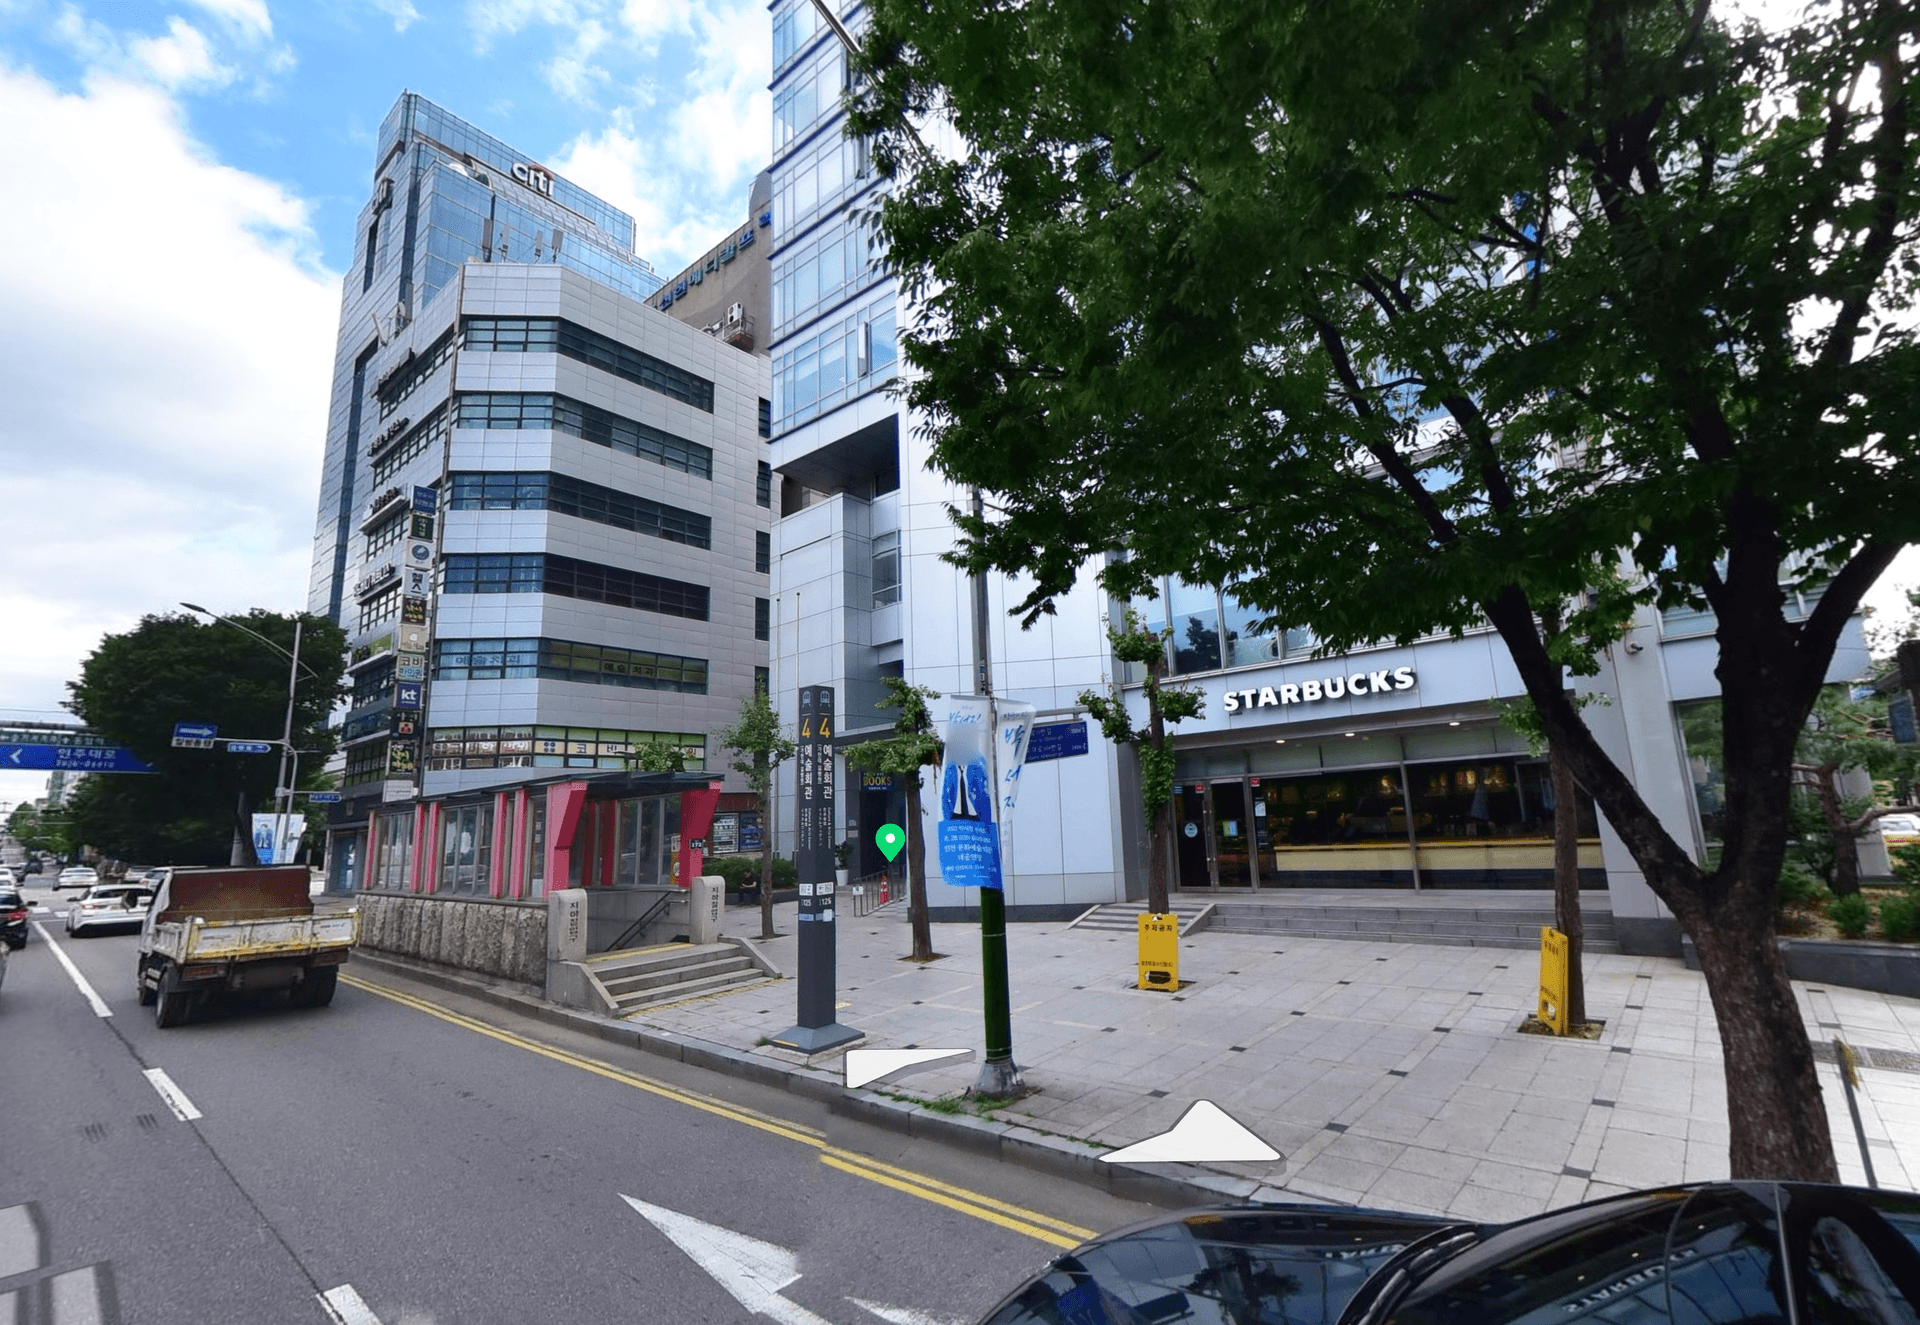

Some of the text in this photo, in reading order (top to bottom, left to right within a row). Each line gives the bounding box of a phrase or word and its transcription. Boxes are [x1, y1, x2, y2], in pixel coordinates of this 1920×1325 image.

[513, 163, 555, 196] citi
[401, 688, 417, 700] kt
[1223, 666, 1415, 712] STARBUCKS
[801, 718, 811, 738] 4
[819, 717, 831, 738] 4
[57, 748, 116, 759] 인주대로
[804, 744, 813, 800] 예술회관
[823, 744, 833, 799] 예술회관
[863, 776, 892, 786] BOOKS
